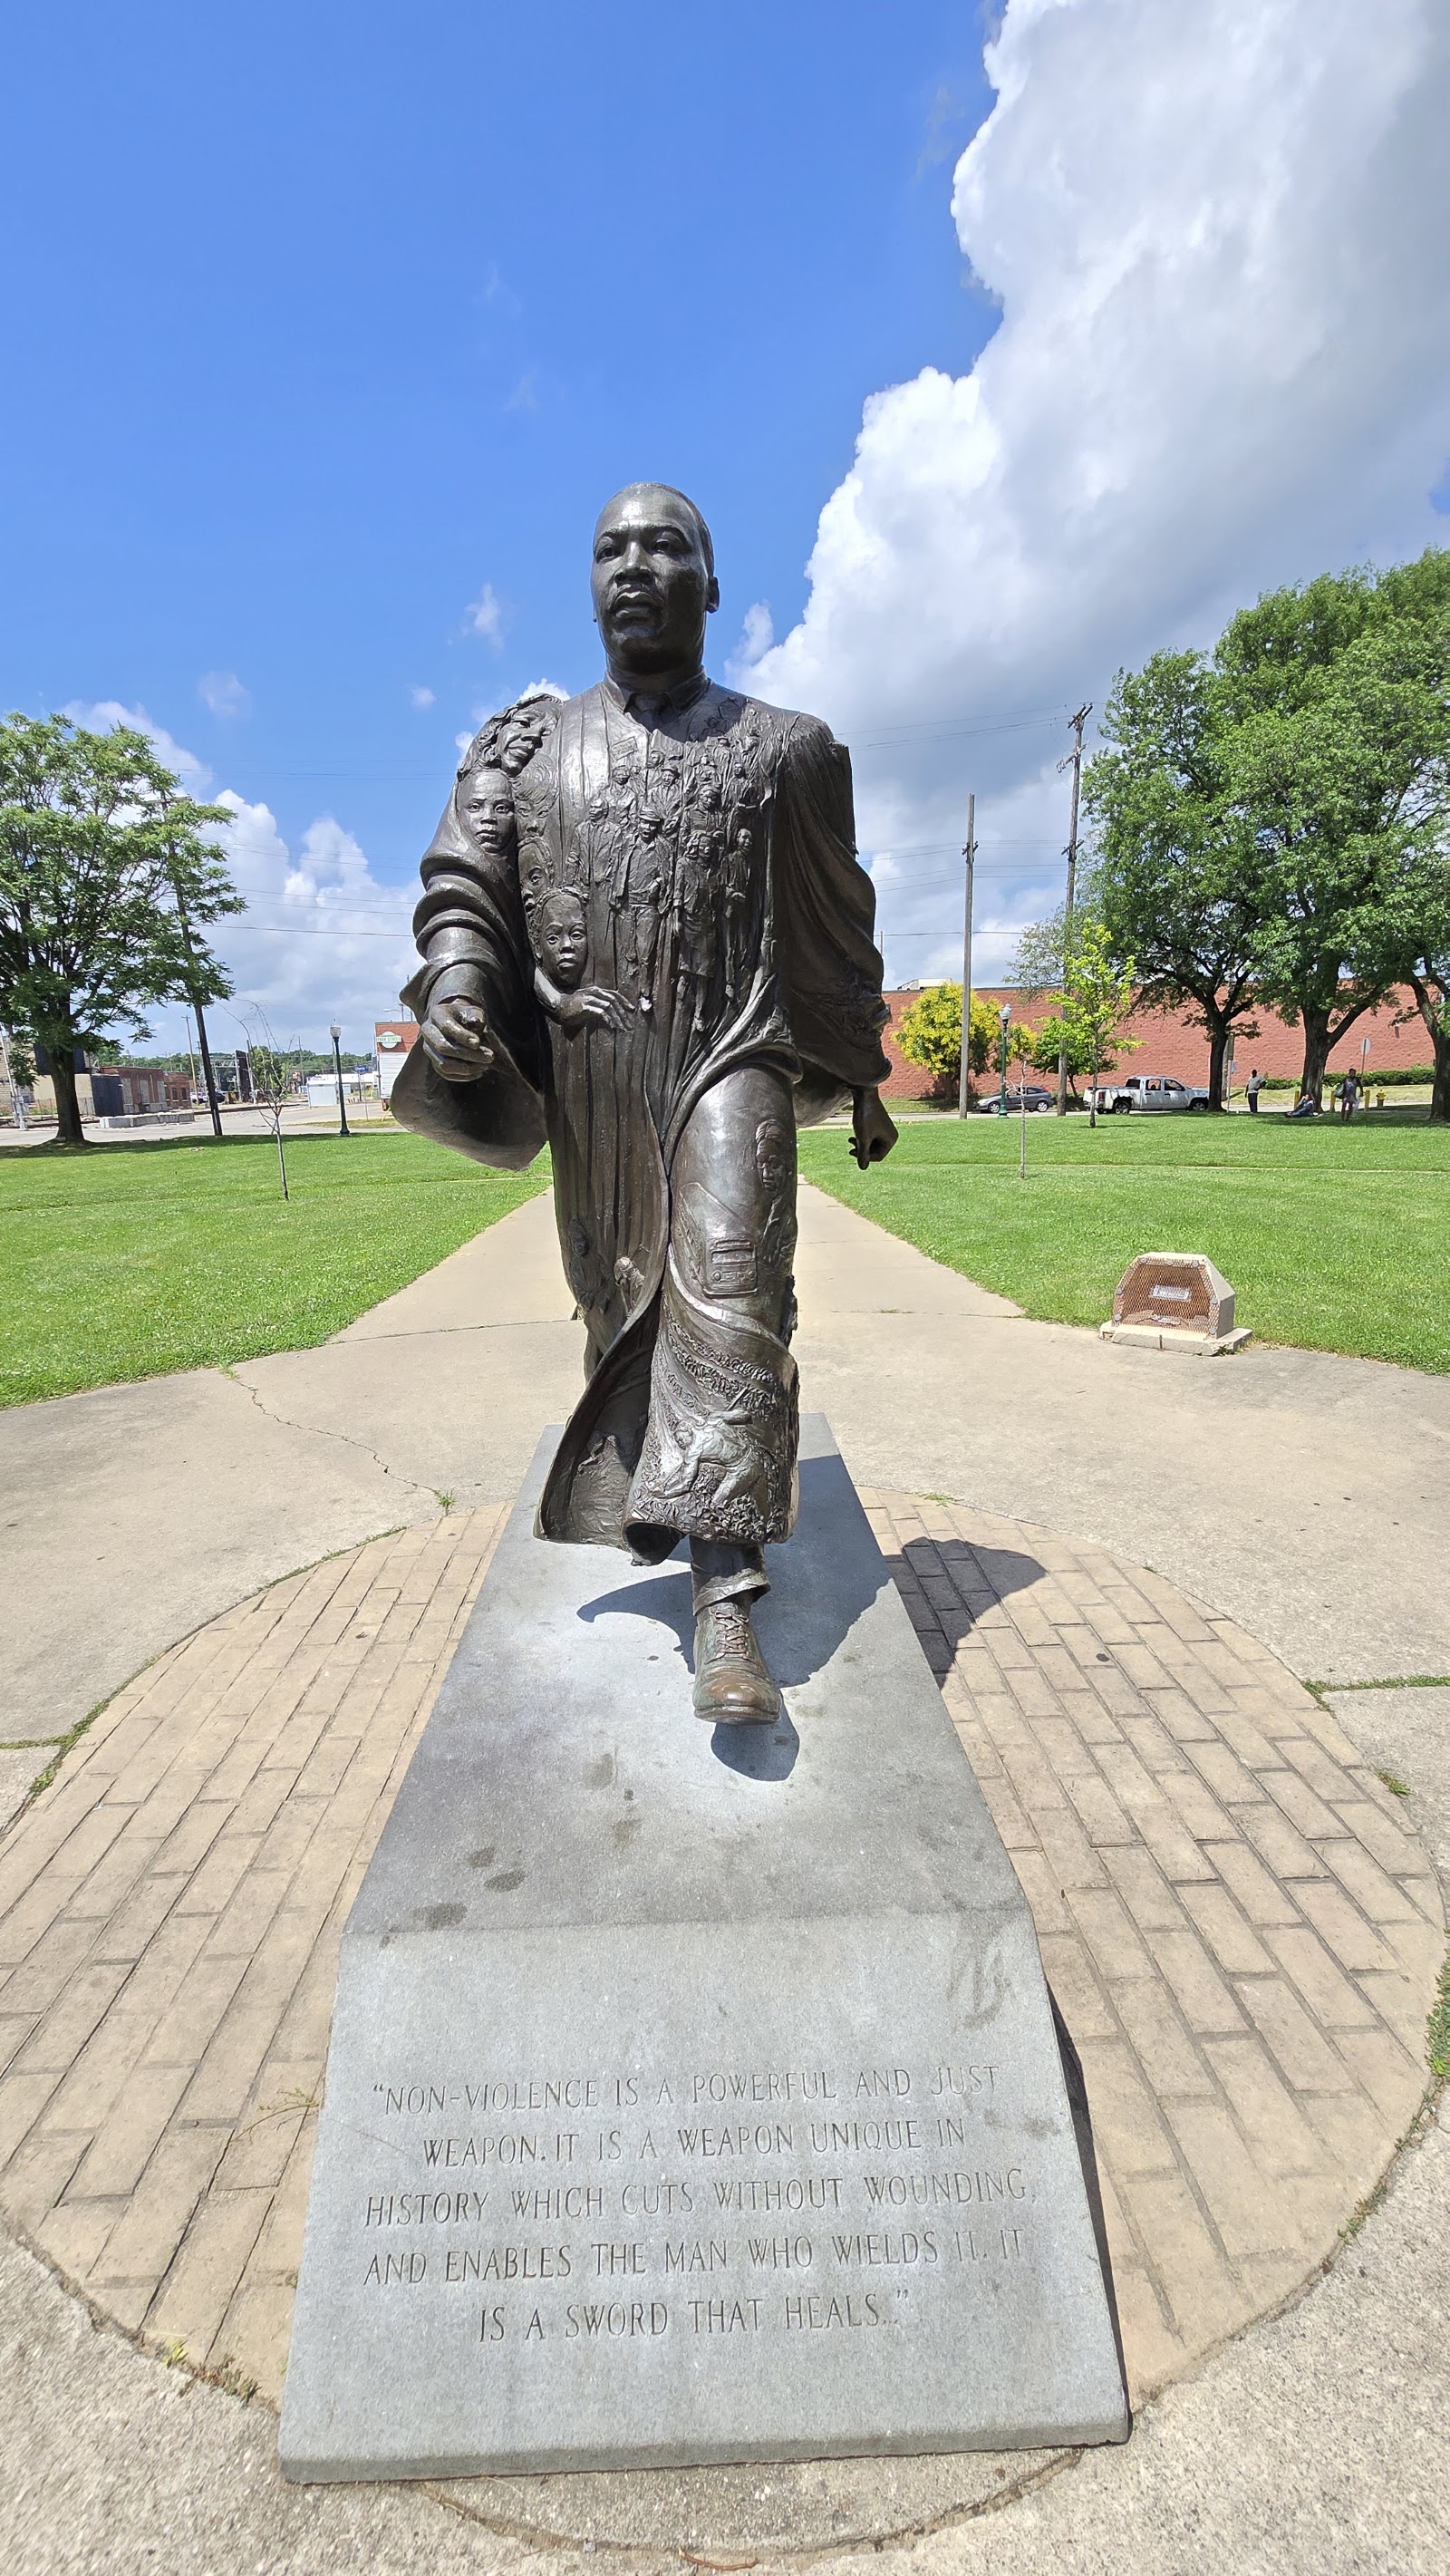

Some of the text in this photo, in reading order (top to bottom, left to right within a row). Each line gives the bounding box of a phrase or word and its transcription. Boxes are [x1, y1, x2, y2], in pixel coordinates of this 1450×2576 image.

[615, 2077, 640, 2107] IS
[655, 2077, 674, 2106] A
[692, 2070, 837, 2104] POWERFUL
[855, 2068, 912, 2098] AND
[930, 2065, 1000, 2097] JUST
[423, 2117, 966, 2168] WEAPON. IT IS A WEAPON UNIQUE IN
[363, 2191, 490, 2227] HISTORY
[510, 2186, 604, 2220] WHICH
[622, 2181, 694, 2216] CUTS
[713, 2178, 844, 2212] WITHOUT
[362, 2228, 1025, 2287] AND ENABLES THE MAN WHO WIELDS IT. IT
[478, 2305, 506, 2344] IS
[524, 2306, 546, 2342] A
[564, 2301, 669, 2339] SWORD
[687, 2297, 764, 2335] THAT
